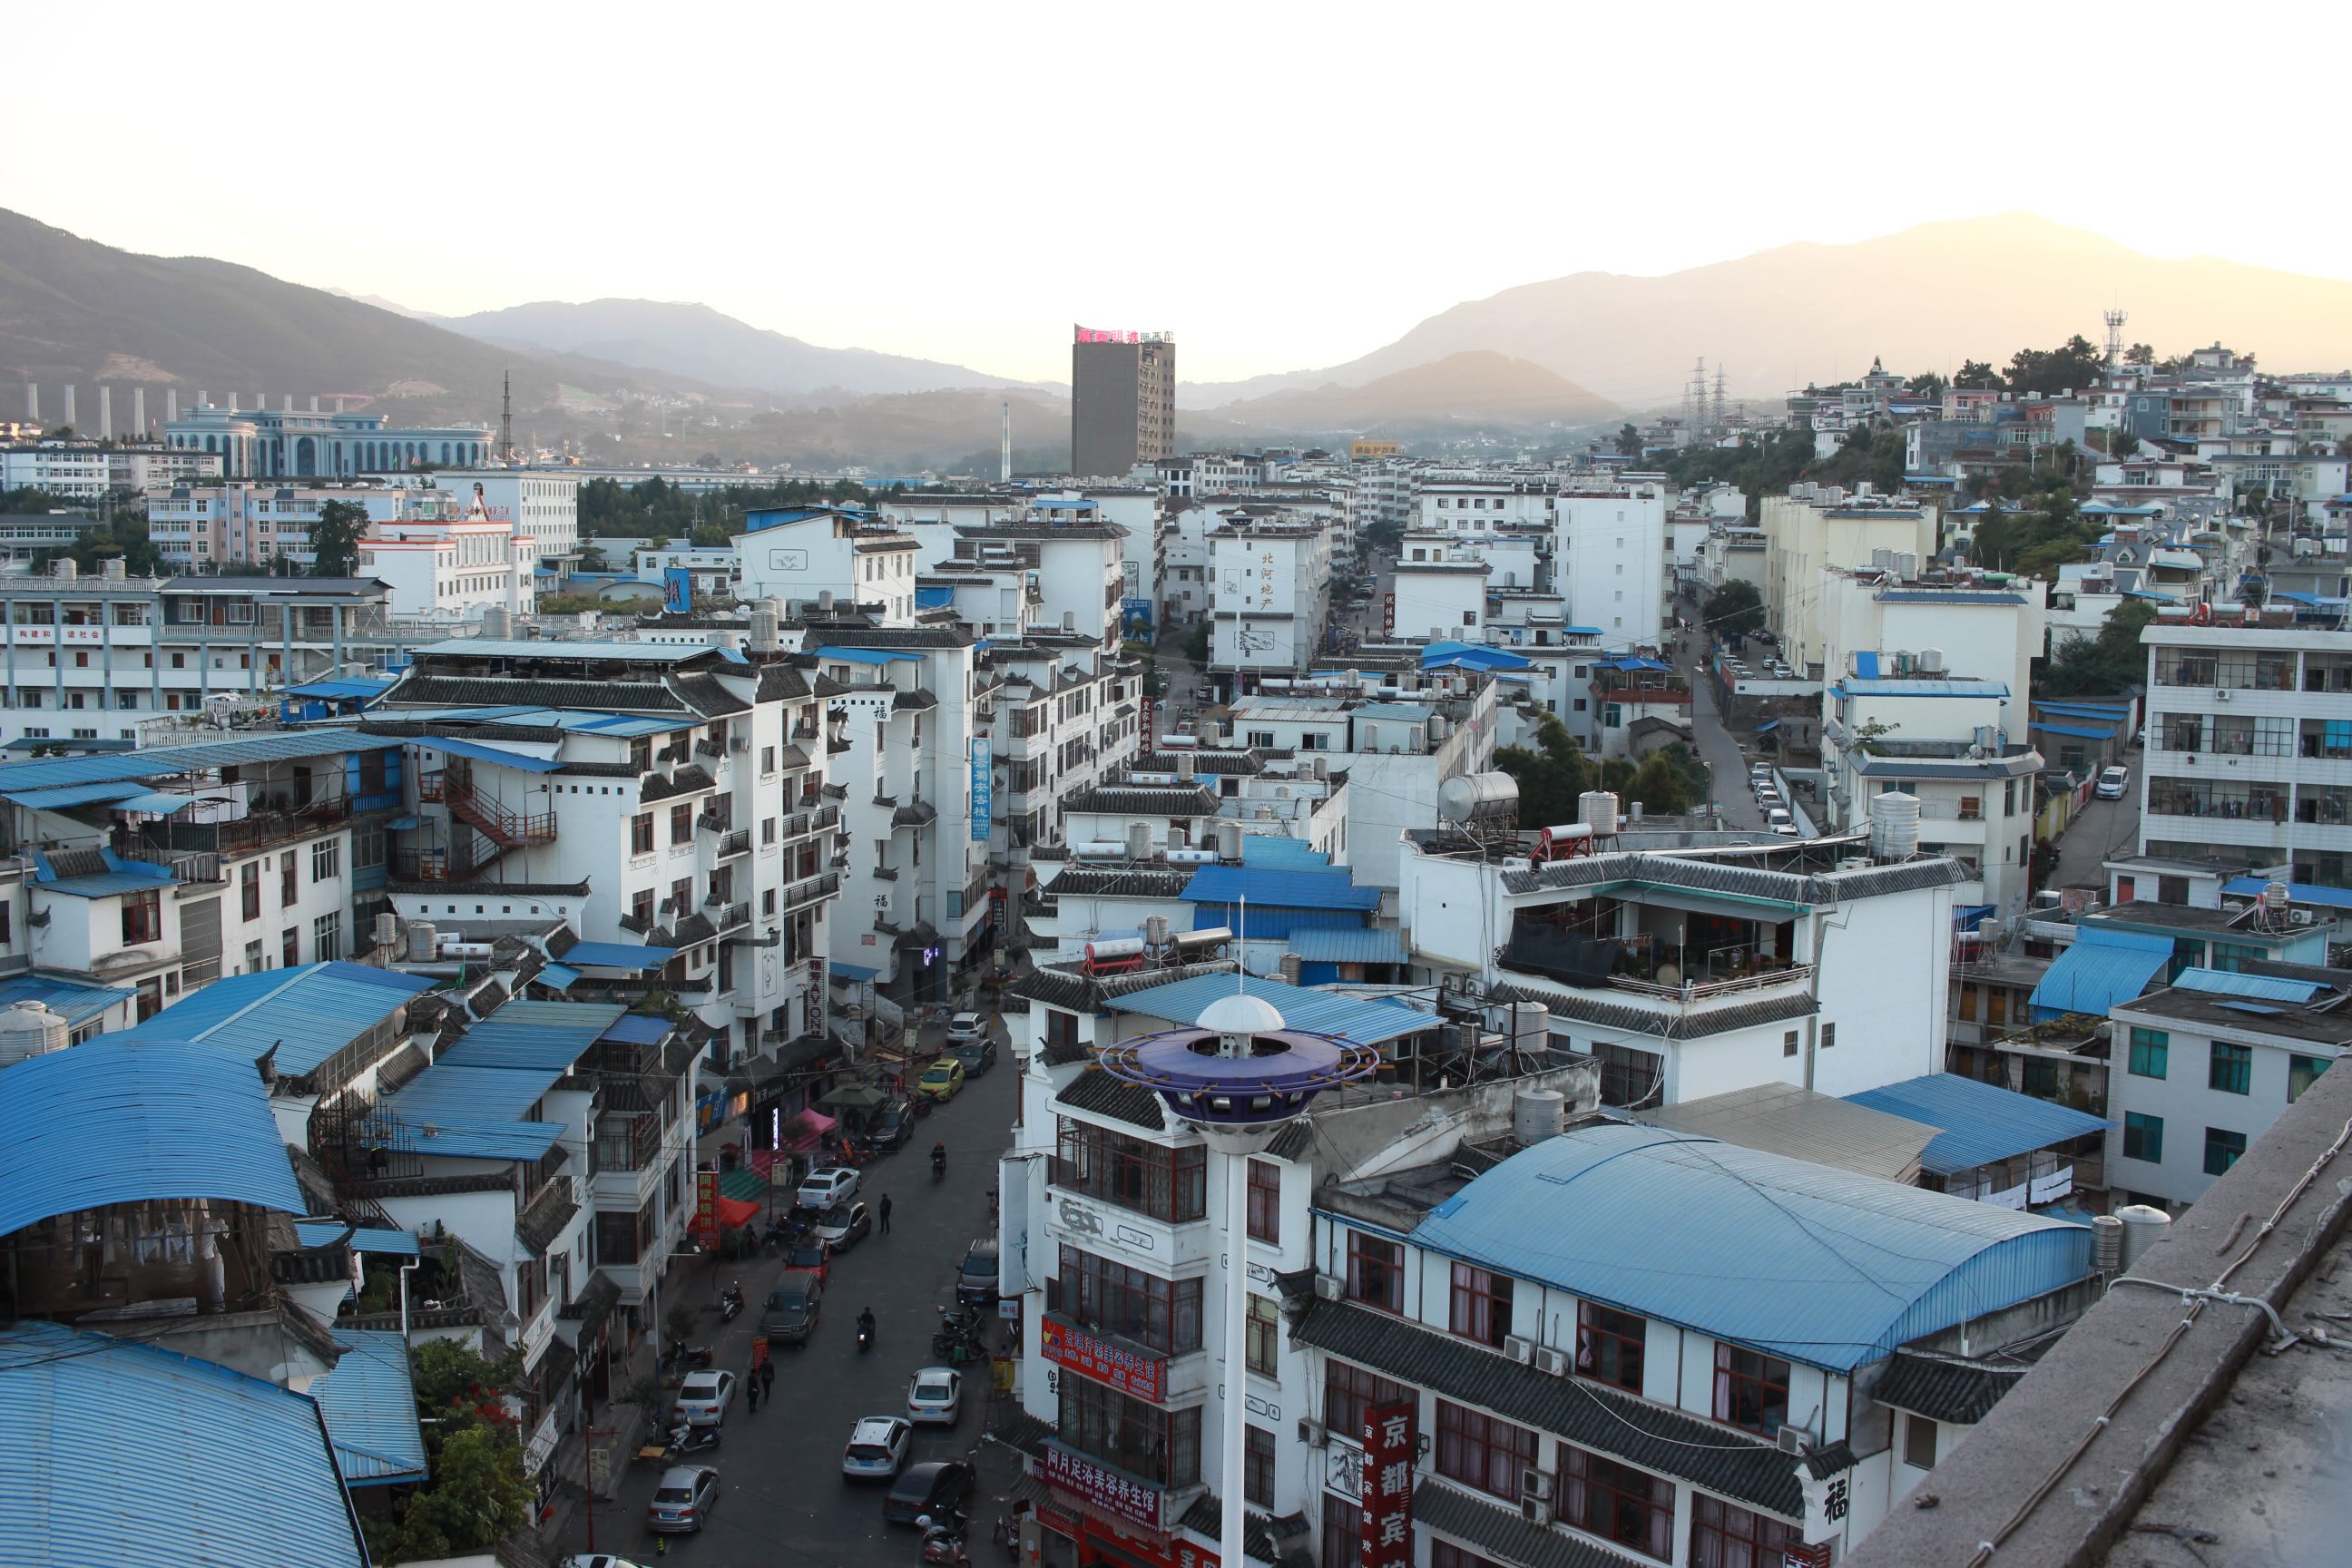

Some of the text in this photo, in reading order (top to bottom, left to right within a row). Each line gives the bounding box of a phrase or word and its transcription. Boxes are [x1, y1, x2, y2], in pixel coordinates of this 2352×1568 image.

[1260, 553, 1274, 610] 北河地产
[20, 630, 99, 639] 构建和谐社会
[873, 706, 887, 720] 福
[974, 759, 988, 817] 云蜀安客栈
[874, 895, 887, 907] 福
[1047, 1446, 1155, 1513] 阿月足浴美容养生馆
[1824, 1478, 1848, 1525] 福
